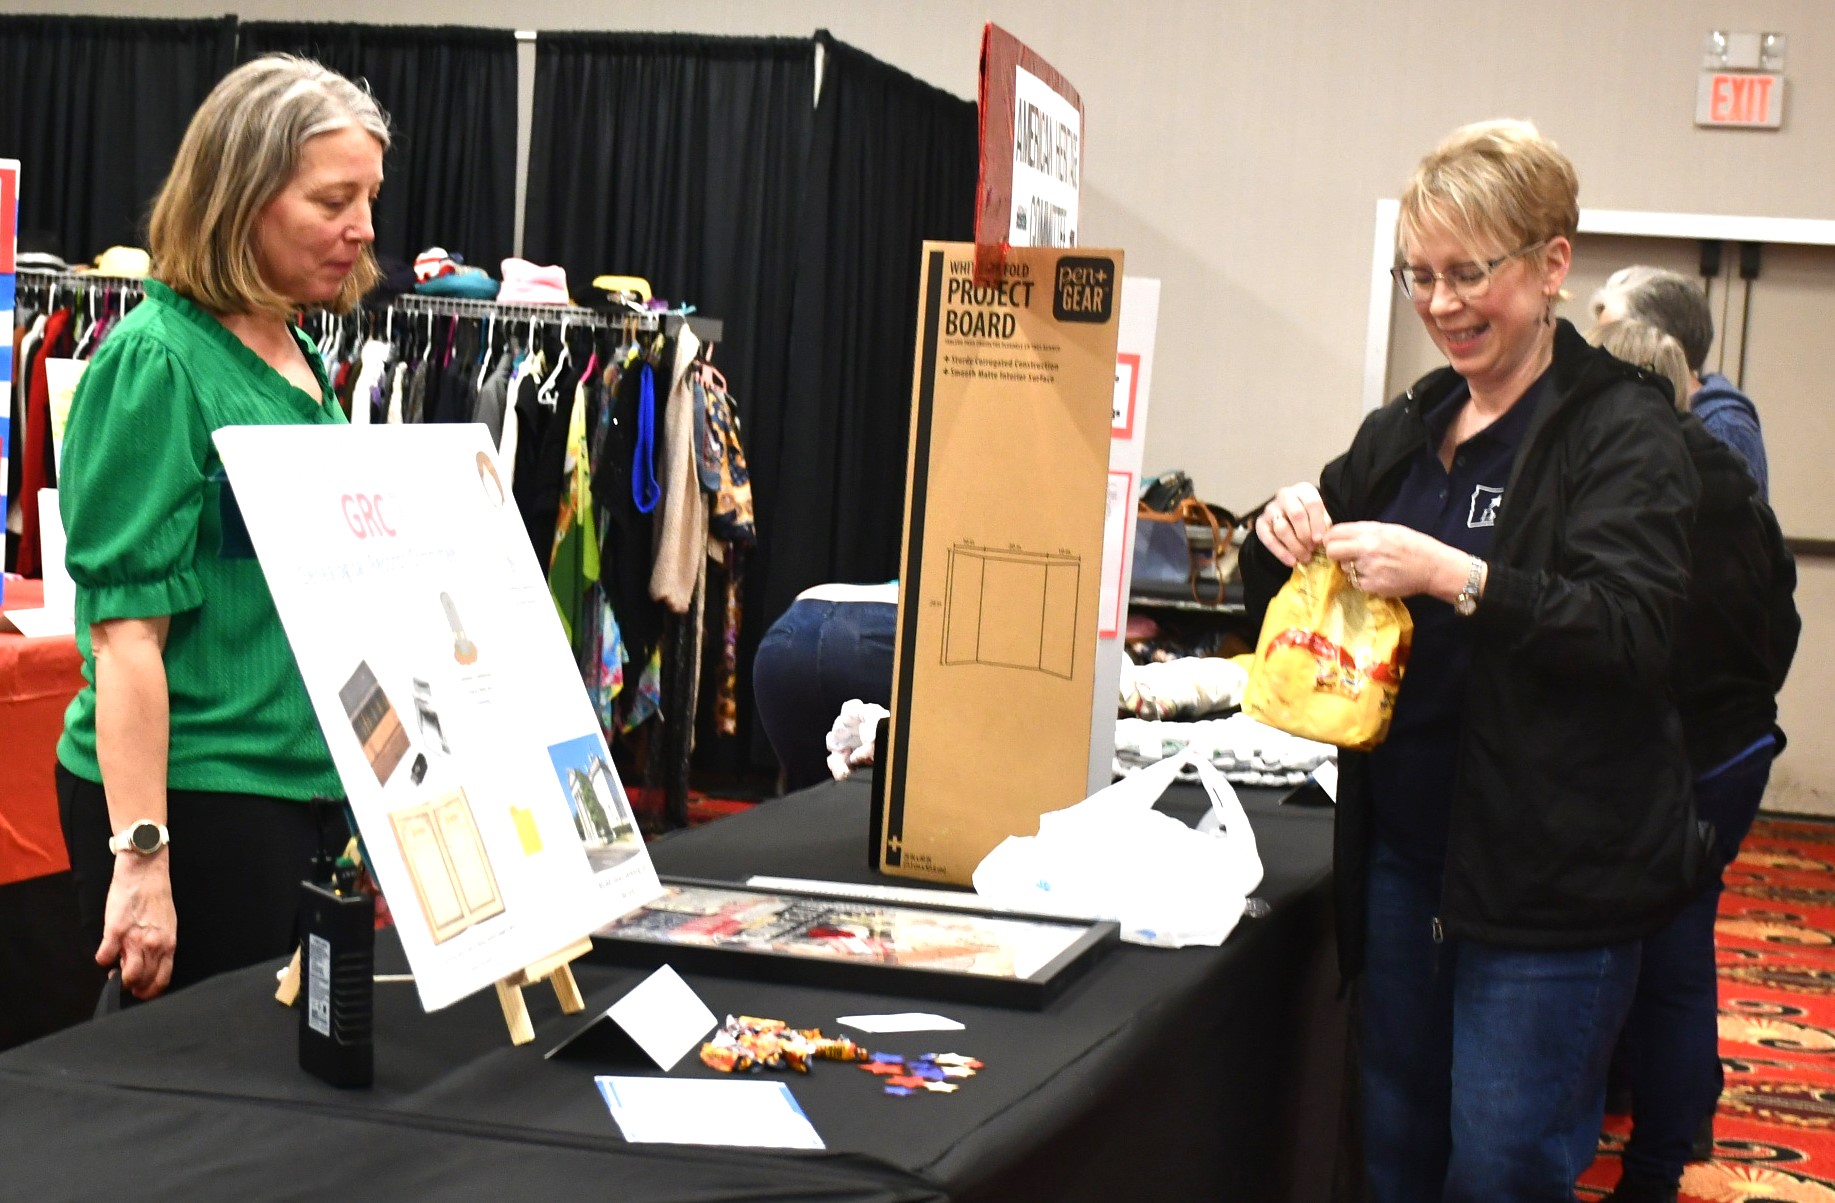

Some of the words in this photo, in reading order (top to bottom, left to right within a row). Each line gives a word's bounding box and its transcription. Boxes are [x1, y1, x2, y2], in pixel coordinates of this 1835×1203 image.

[1710, 75, 1775, 122] EXIT
[947, 278, 1034, 308] PROJECT
[1062, 286, 1104, 313] GEAR
[945, 310, 1016, 339] BOARD
[340, 493, 397, 540] GRC
